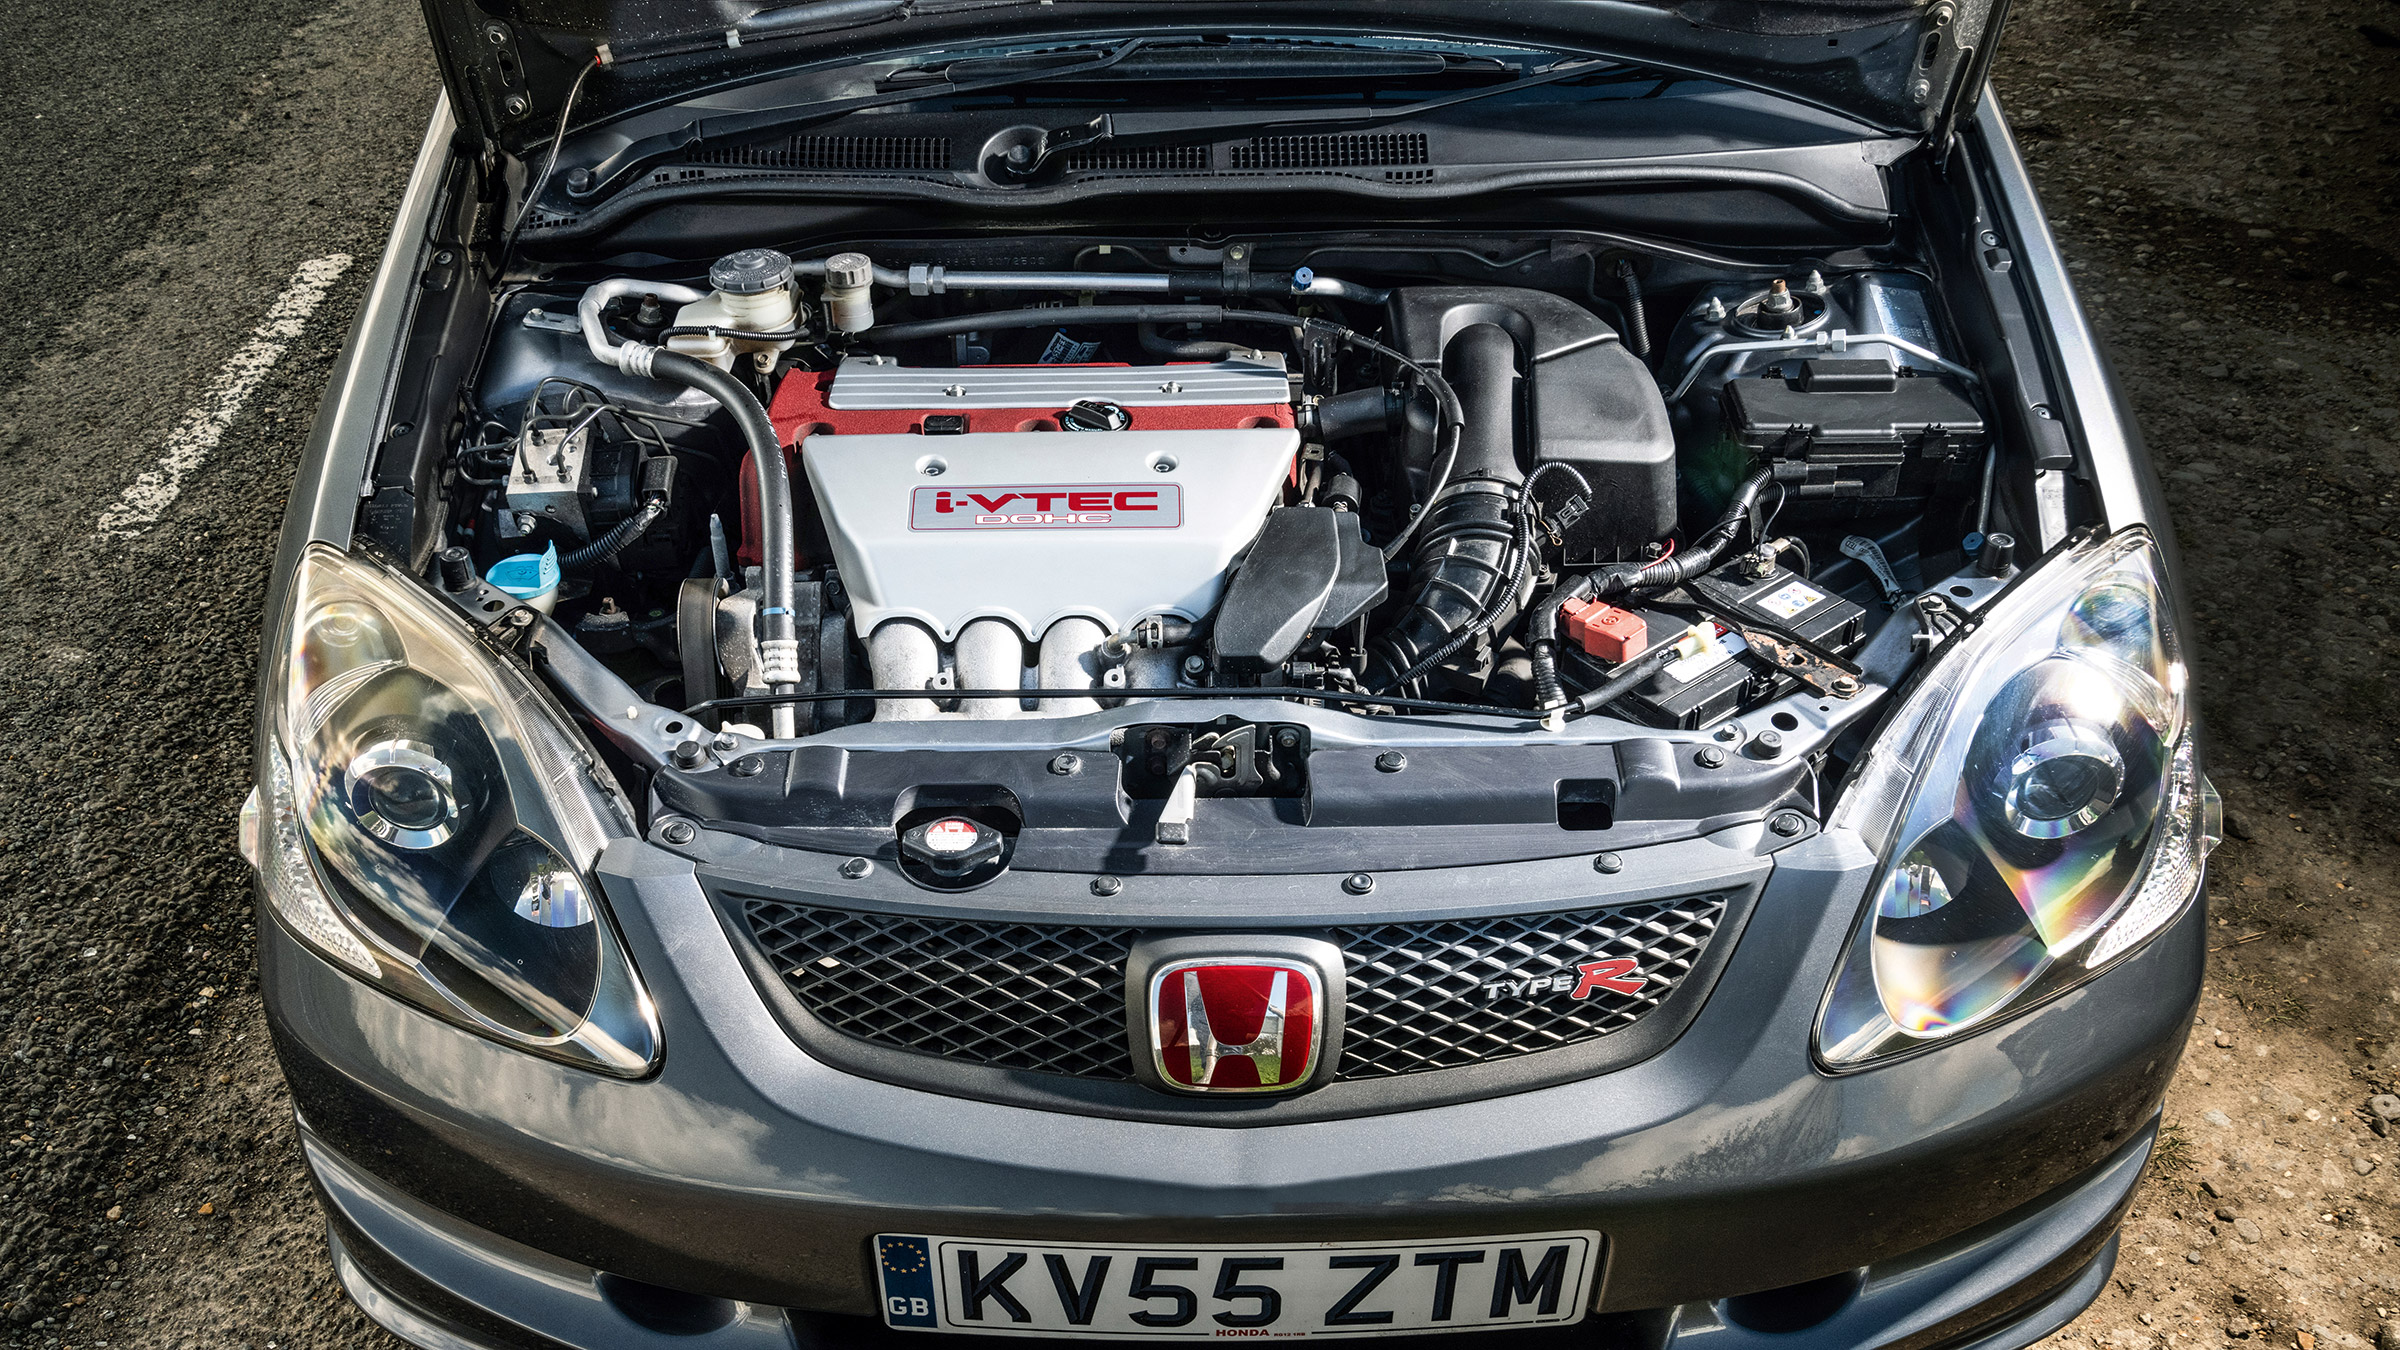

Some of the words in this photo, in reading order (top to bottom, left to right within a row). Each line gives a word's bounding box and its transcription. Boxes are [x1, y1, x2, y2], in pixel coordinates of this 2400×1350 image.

[935, 491, 1158, 514] i-VTEC
[975, 512, 1112, 525] DOHC
[1482, 974, 1575, 1000] TYPE
[1570, 955, 1649, 1001] R
[957, 1249, 1284, 1327] KV55
[1324, 1245, 1568, 1325] ZTM
[888, 1296, 929, 1317] GB
[1215, 1328, 1270, 1337] HONDA
